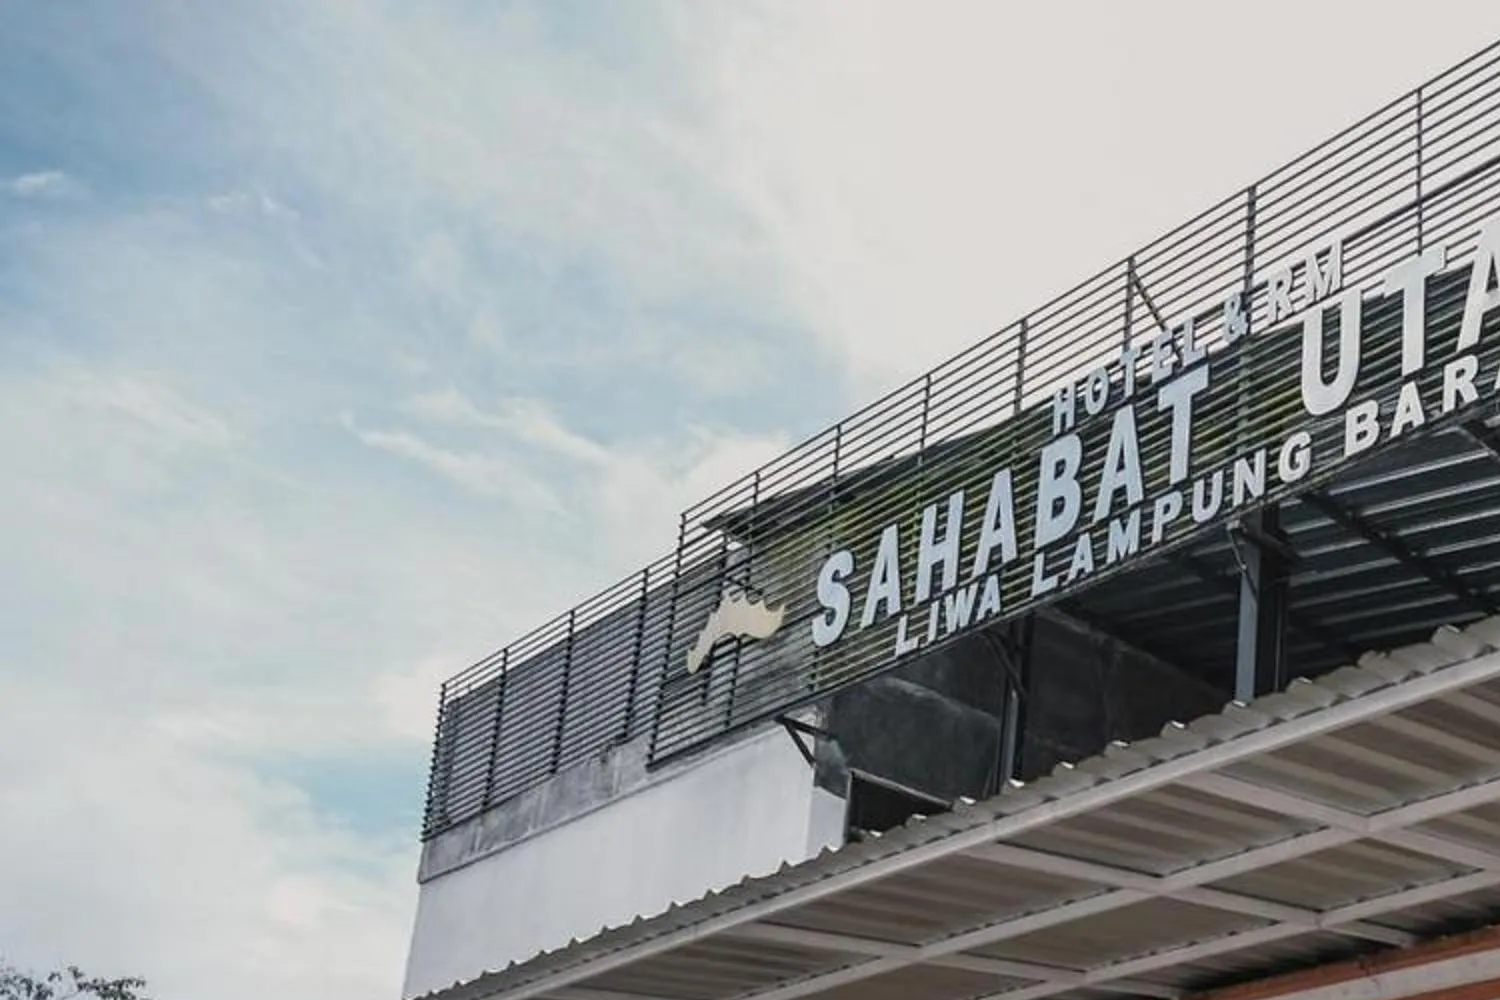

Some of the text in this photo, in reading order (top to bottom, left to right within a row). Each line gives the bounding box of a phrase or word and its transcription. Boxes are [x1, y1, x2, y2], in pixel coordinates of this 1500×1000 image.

[1052, 238, 1343, 435] HOTEL & RM
[812, 364, 1209, 647] SAHABAT
[896, 576, 1000, 659] LIWA
[1032, 432, 1311, 599] LAMPUNG
